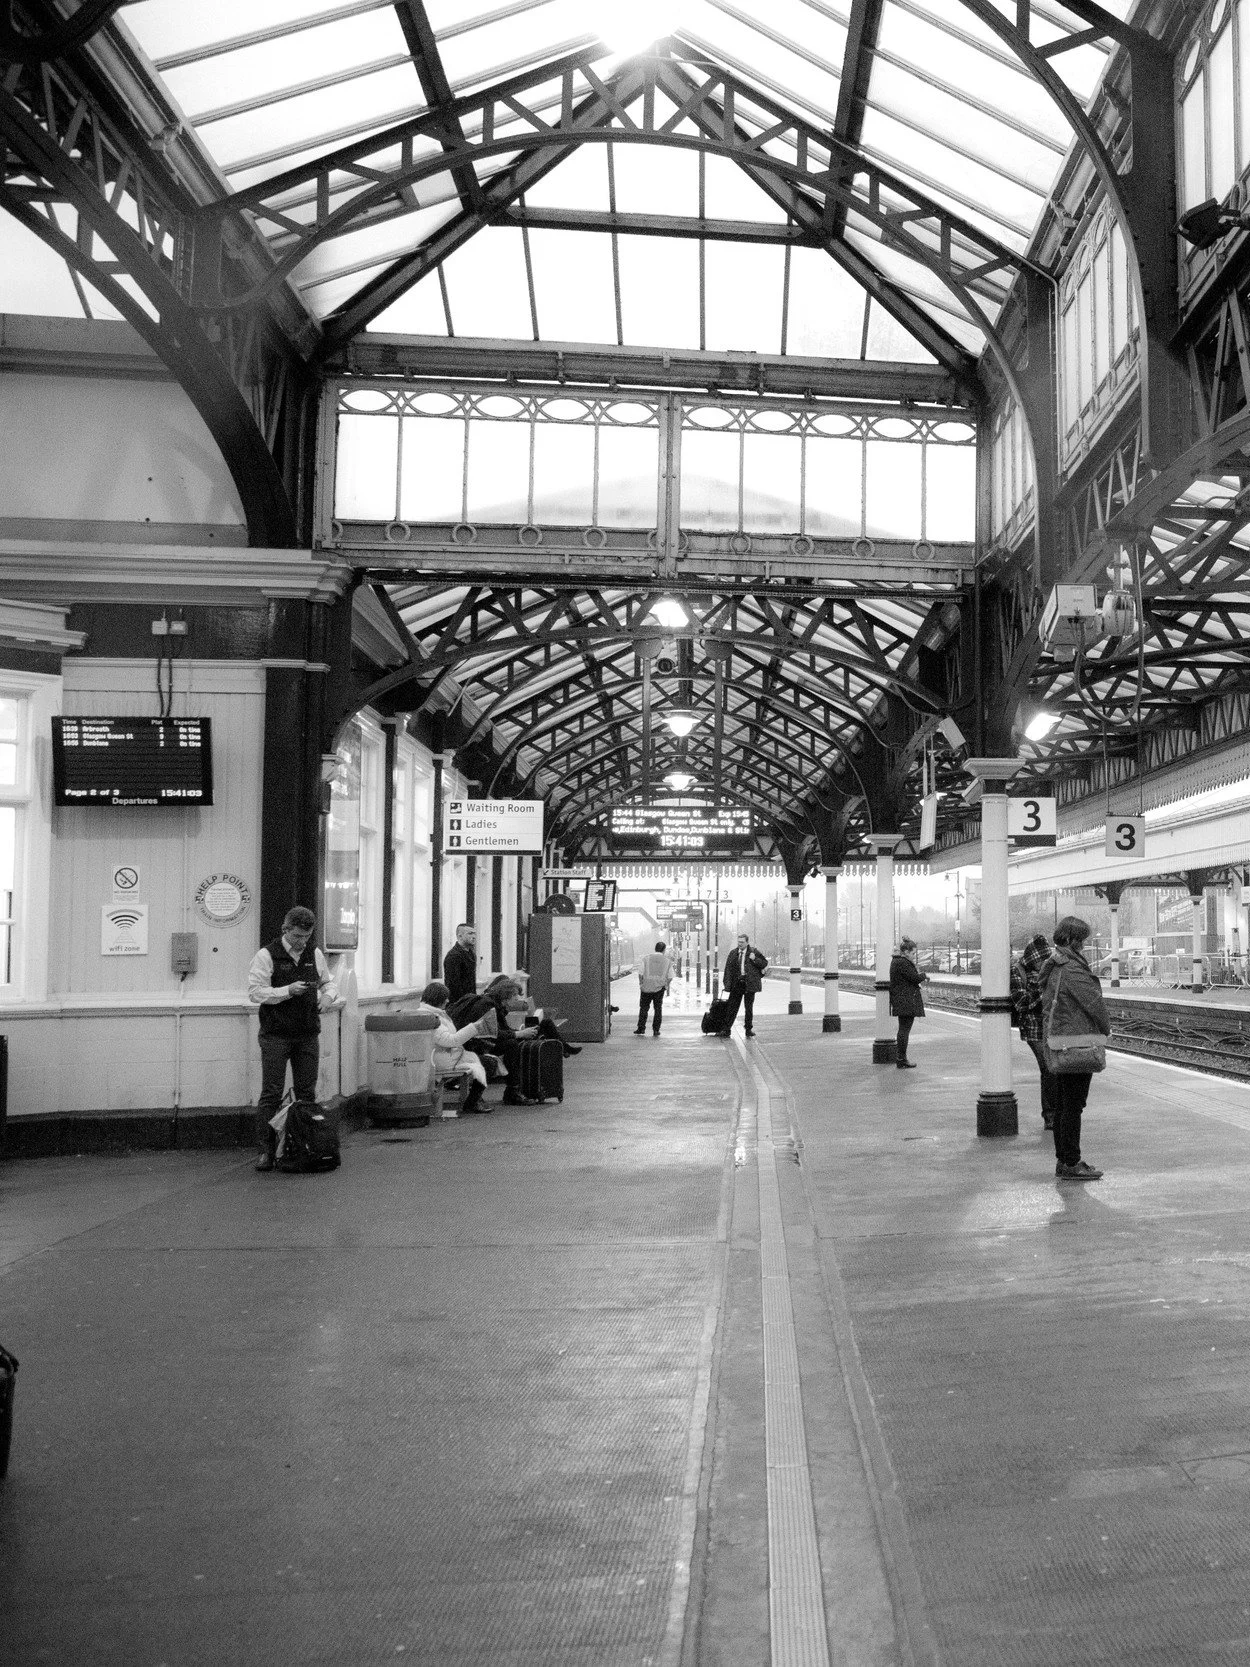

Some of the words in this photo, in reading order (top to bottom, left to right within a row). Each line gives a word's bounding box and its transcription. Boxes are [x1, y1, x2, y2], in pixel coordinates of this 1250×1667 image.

[65, 789, 87, 797] Page
[161, 789, 203, 797] 15:41:03
[112, 797, 158, 805] Departures
[466, 803, 505, 814] Waiting
[507, 804, 535, 812] Room
[1022, 800, 1042, 832] 3
[465, 819, 497, 828] Ladies
[465, 836, 519, 845] Gentlemen
[660, 835, 704, 846] 15:41:03
[1114, 823, 1136, 851] 3
[196, 875, 218, 896] HELP
[222, 874, 248, 893] POINT
[793, 909, 801, 918] 3
